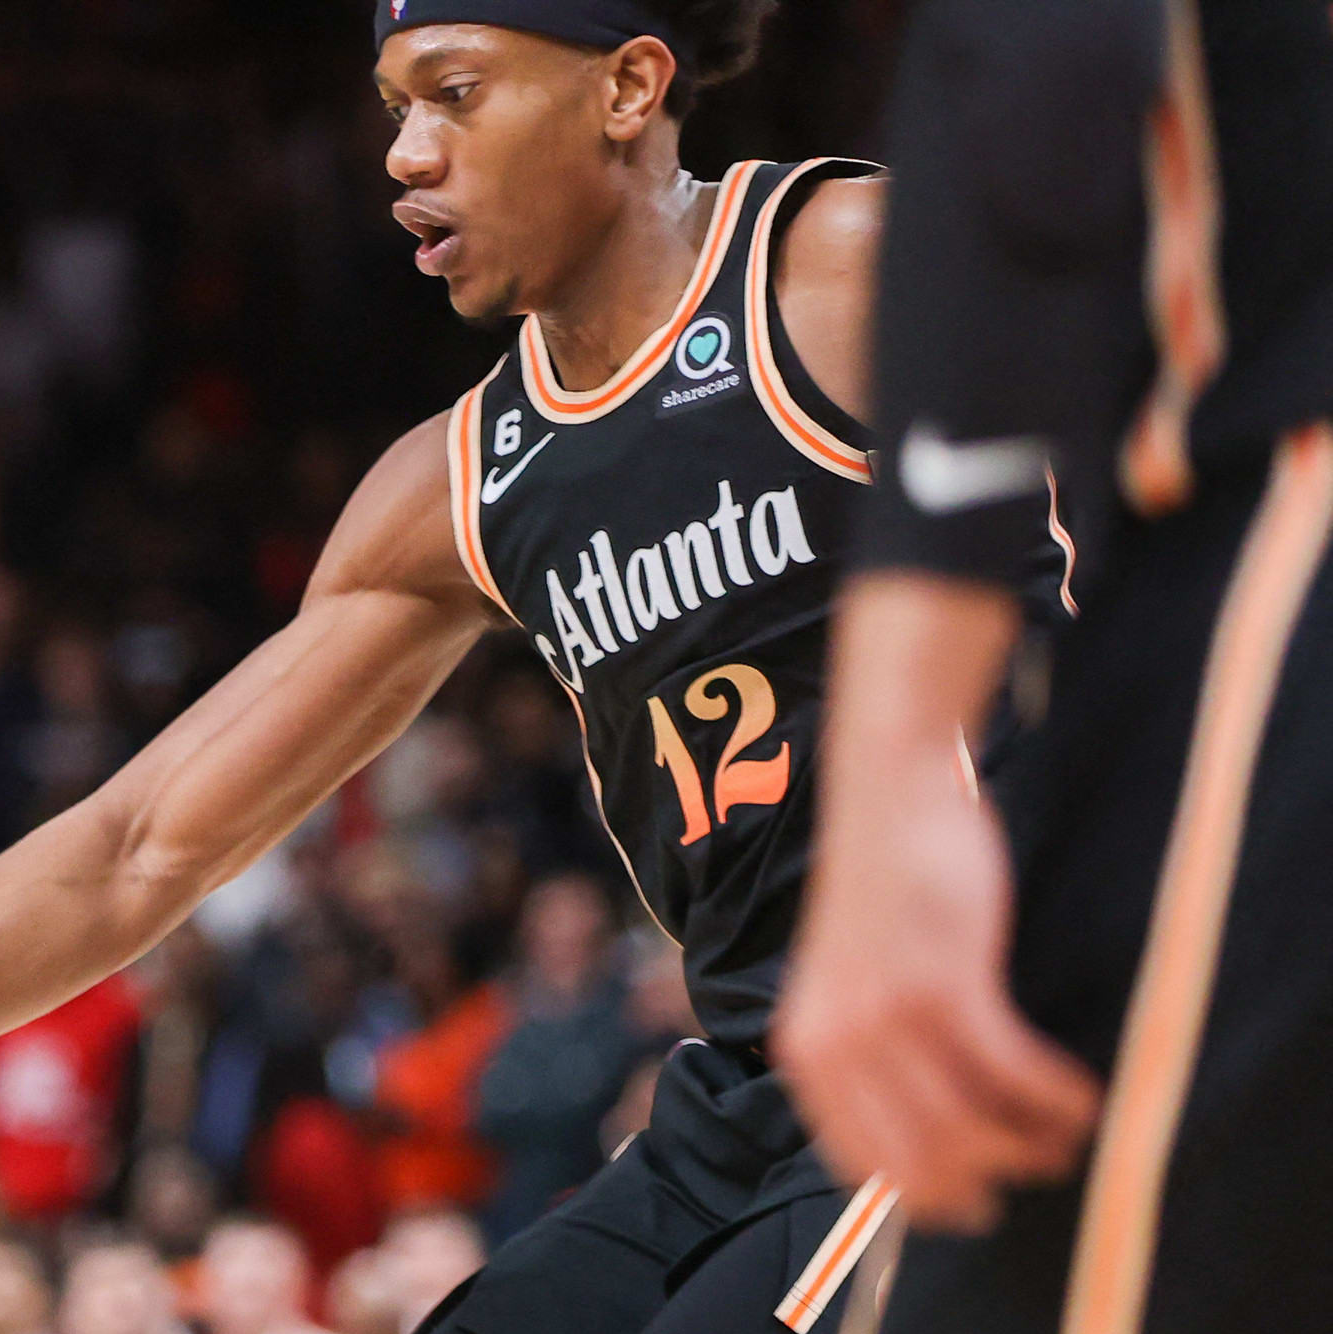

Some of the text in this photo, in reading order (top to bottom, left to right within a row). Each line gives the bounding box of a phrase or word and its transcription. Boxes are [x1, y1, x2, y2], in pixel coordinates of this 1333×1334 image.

[493, 408, 522, 457] 6
[661, 374, 741, 409] sharecare
[535, 479, 817, 695] Atlanta
[646, 663, 790, 847] 12
